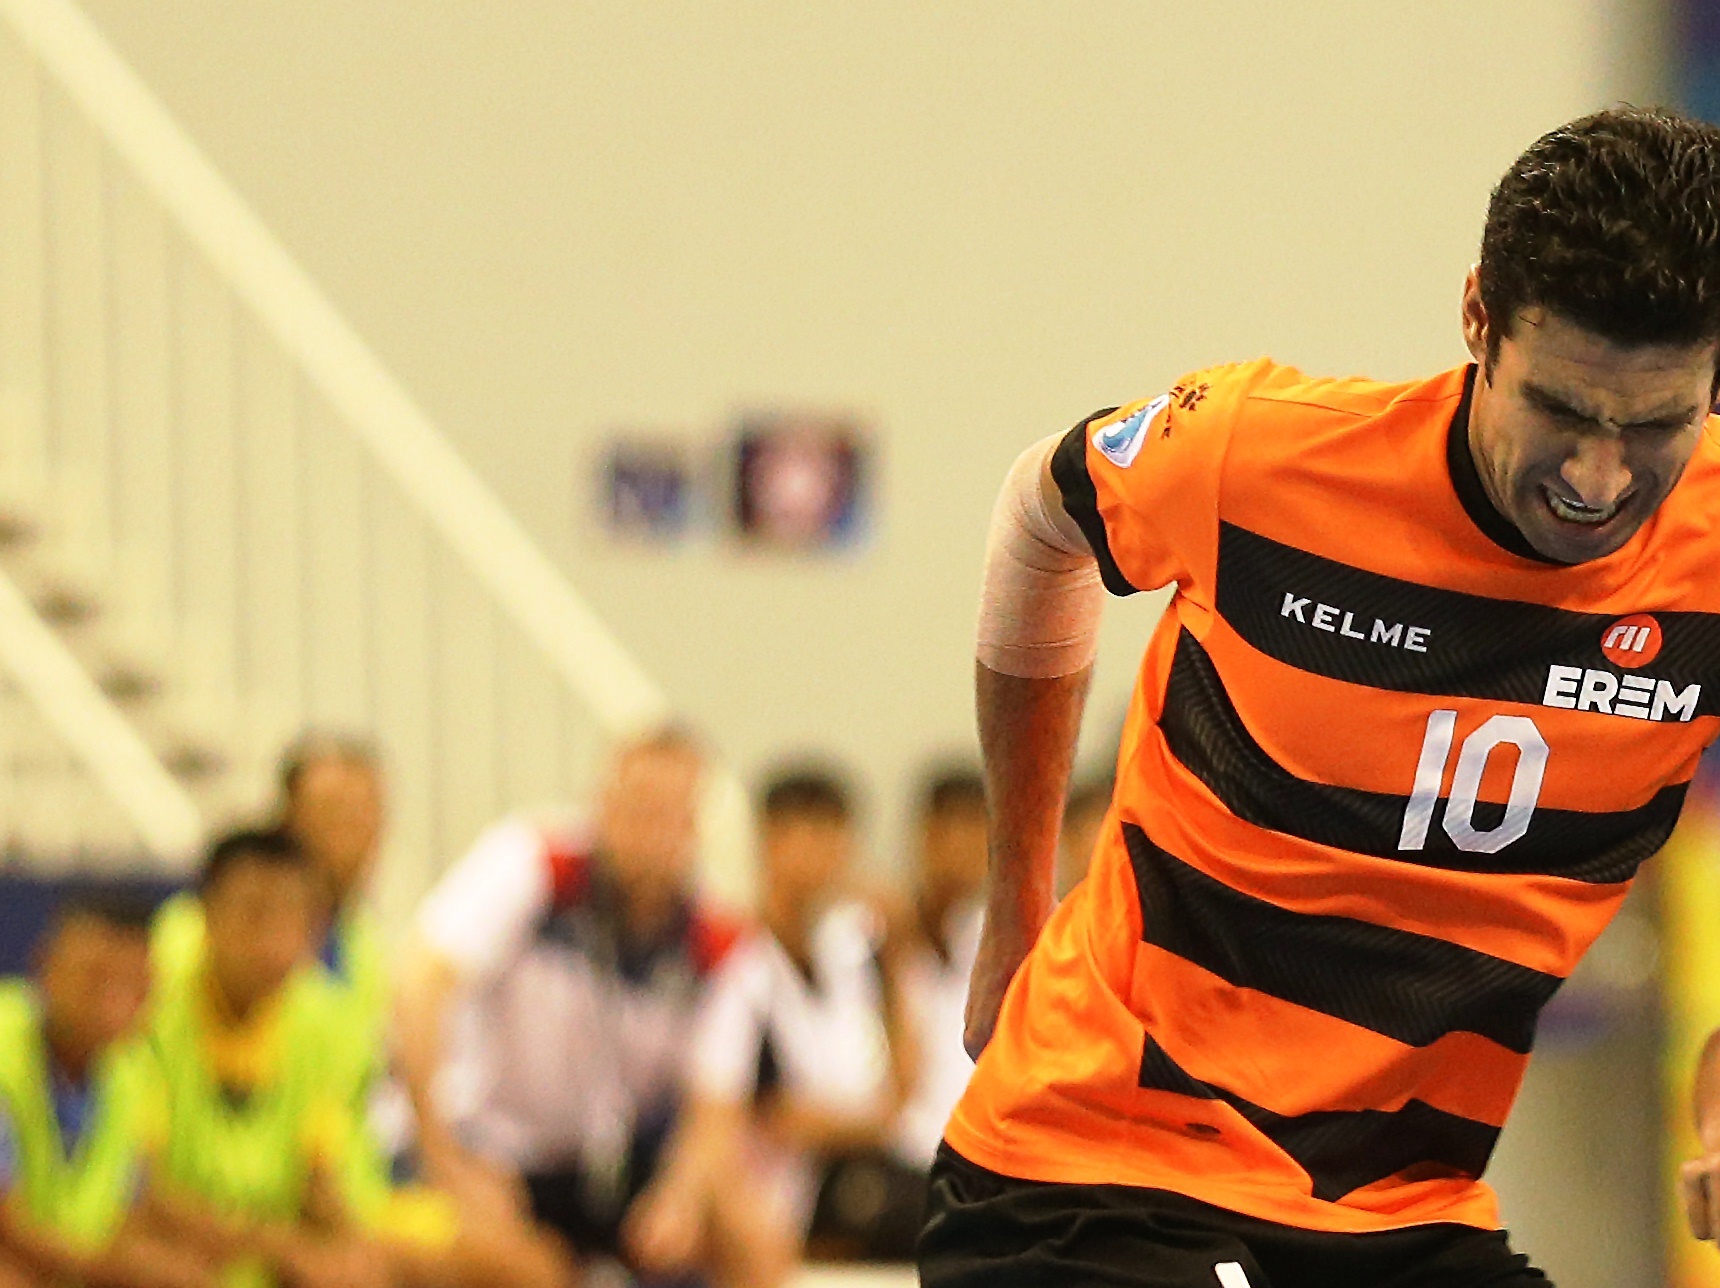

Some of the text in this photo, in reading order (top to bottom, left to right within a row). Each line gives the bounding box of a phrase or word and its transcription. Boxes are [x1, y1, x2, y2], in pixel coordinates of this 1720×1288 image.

[1280, 592, 1432, 653] KELME
[1542, 664, 1702, 722] EREM
[1397, 709, 1551, 855] 10
